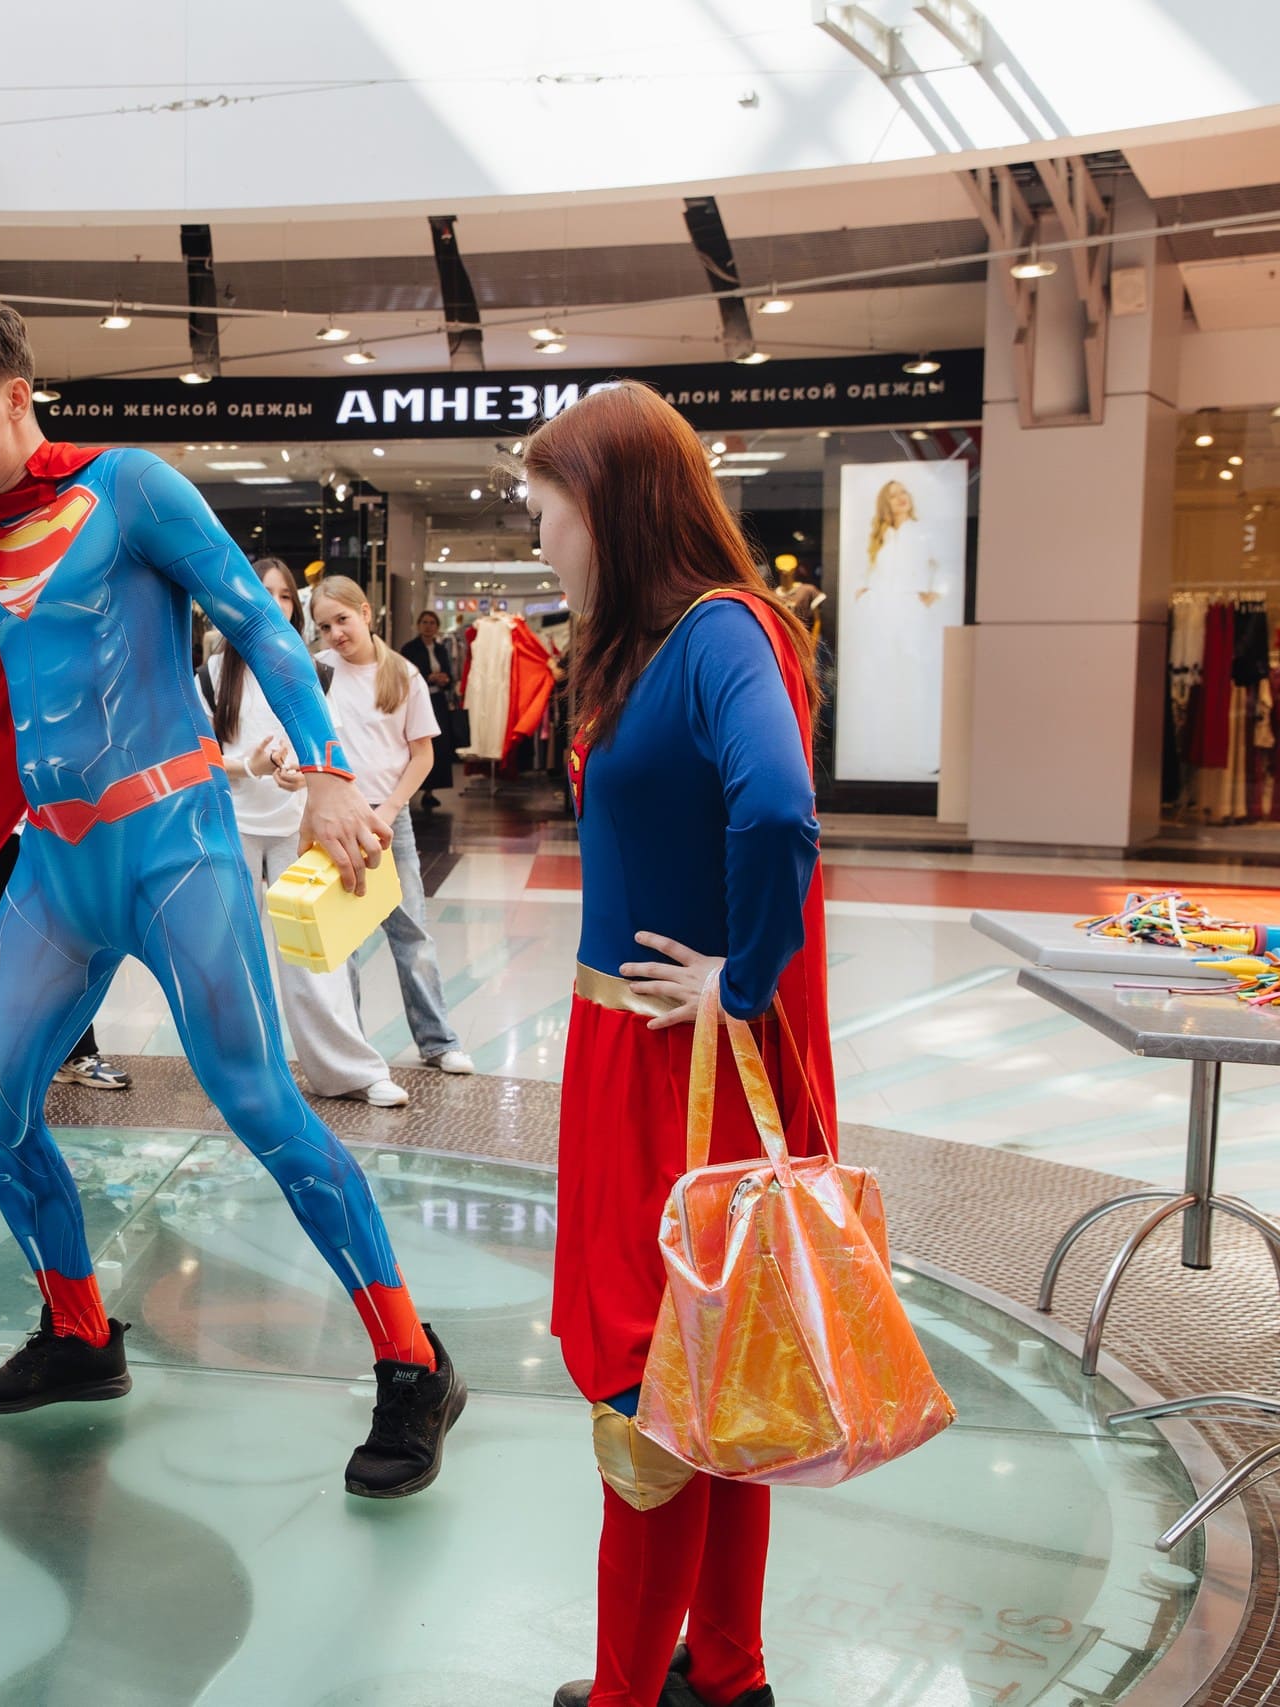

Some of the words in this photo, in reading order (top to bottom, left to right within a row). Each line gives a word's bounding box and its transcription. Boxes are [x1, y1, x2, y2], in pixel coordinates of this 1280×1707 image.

[336, 381, 622, 424] АМНЕЗИ
[664, 389, 720, 405] АЛОН
[730, 383, 837, 402] ЖЕНСКОЙ
[847, 380, 945, 399] ОДЕЖДЫ
[49, 404, 114, 417] САЛОН
[123, 401, 218, 417] ЖЕНСКОЙ
[227, 403, 313, 418] ОДЕЖДЫ
[395, 1370, 419, 1380] NIKE
